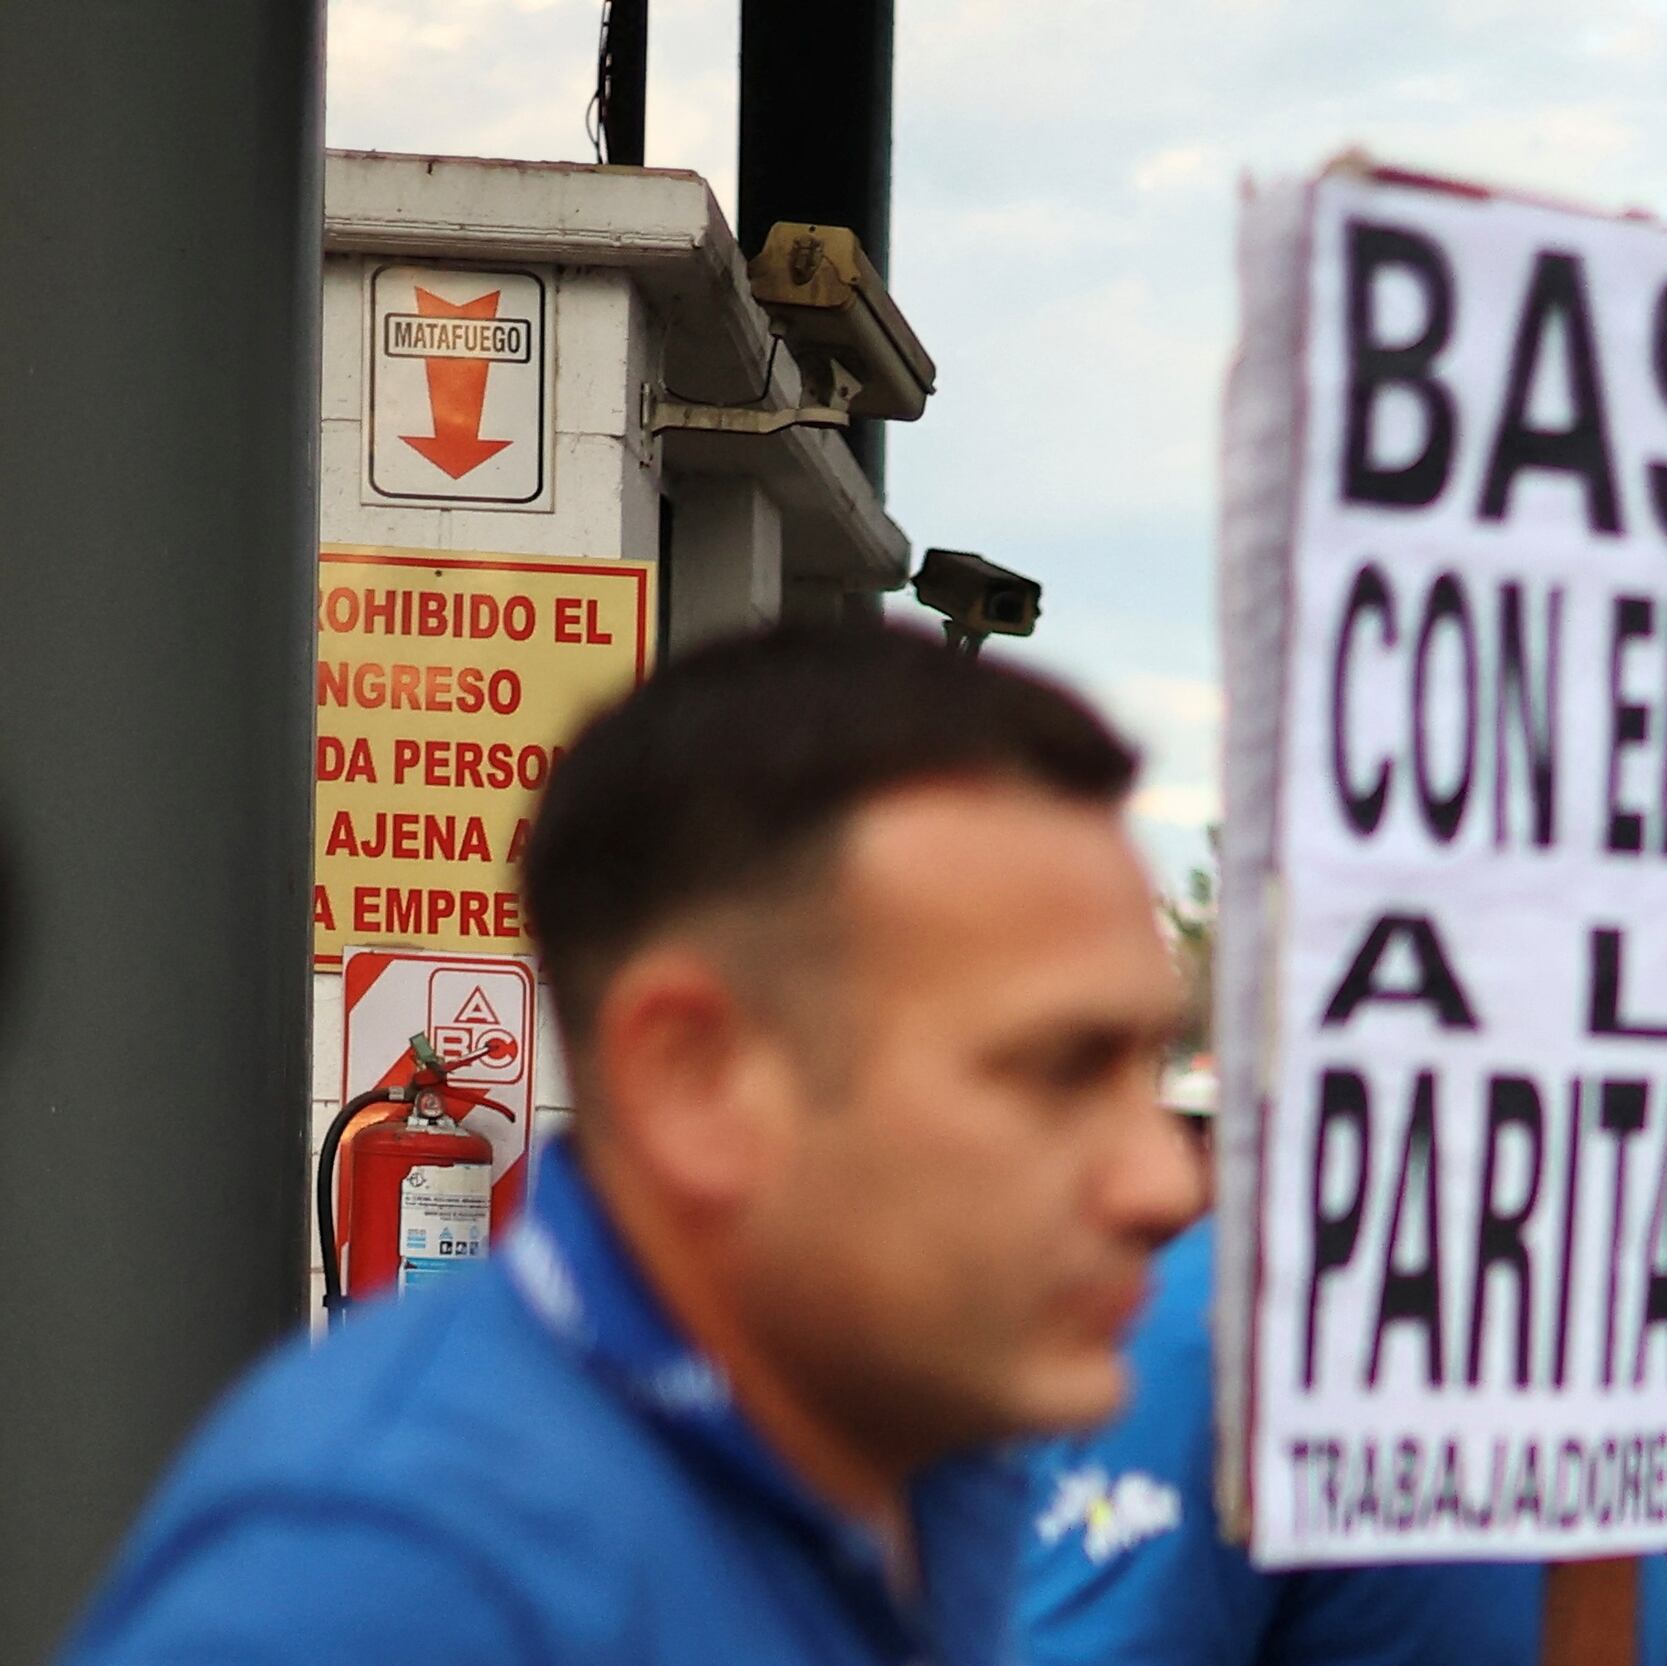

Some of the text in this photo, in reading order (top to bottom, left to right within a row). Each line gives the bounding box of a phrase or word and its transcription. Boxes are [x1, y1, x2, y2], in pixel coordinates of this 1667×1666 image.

[394, 319, 523, 355] MATAFUEGO
[317, 587, 613, 645] OHIBIDO EL
[317, 661, 521, 715] NGRESO
[1332, 563, 1566, 852] CON
[317, 736, 566, 790] DA PERSO
[326, 811, 491, 863] AJENA
[314, 884, 534, 938] A EMPRE
[1320, 912, 1481, 1032] A
[453, 985, 501, 1025] A
